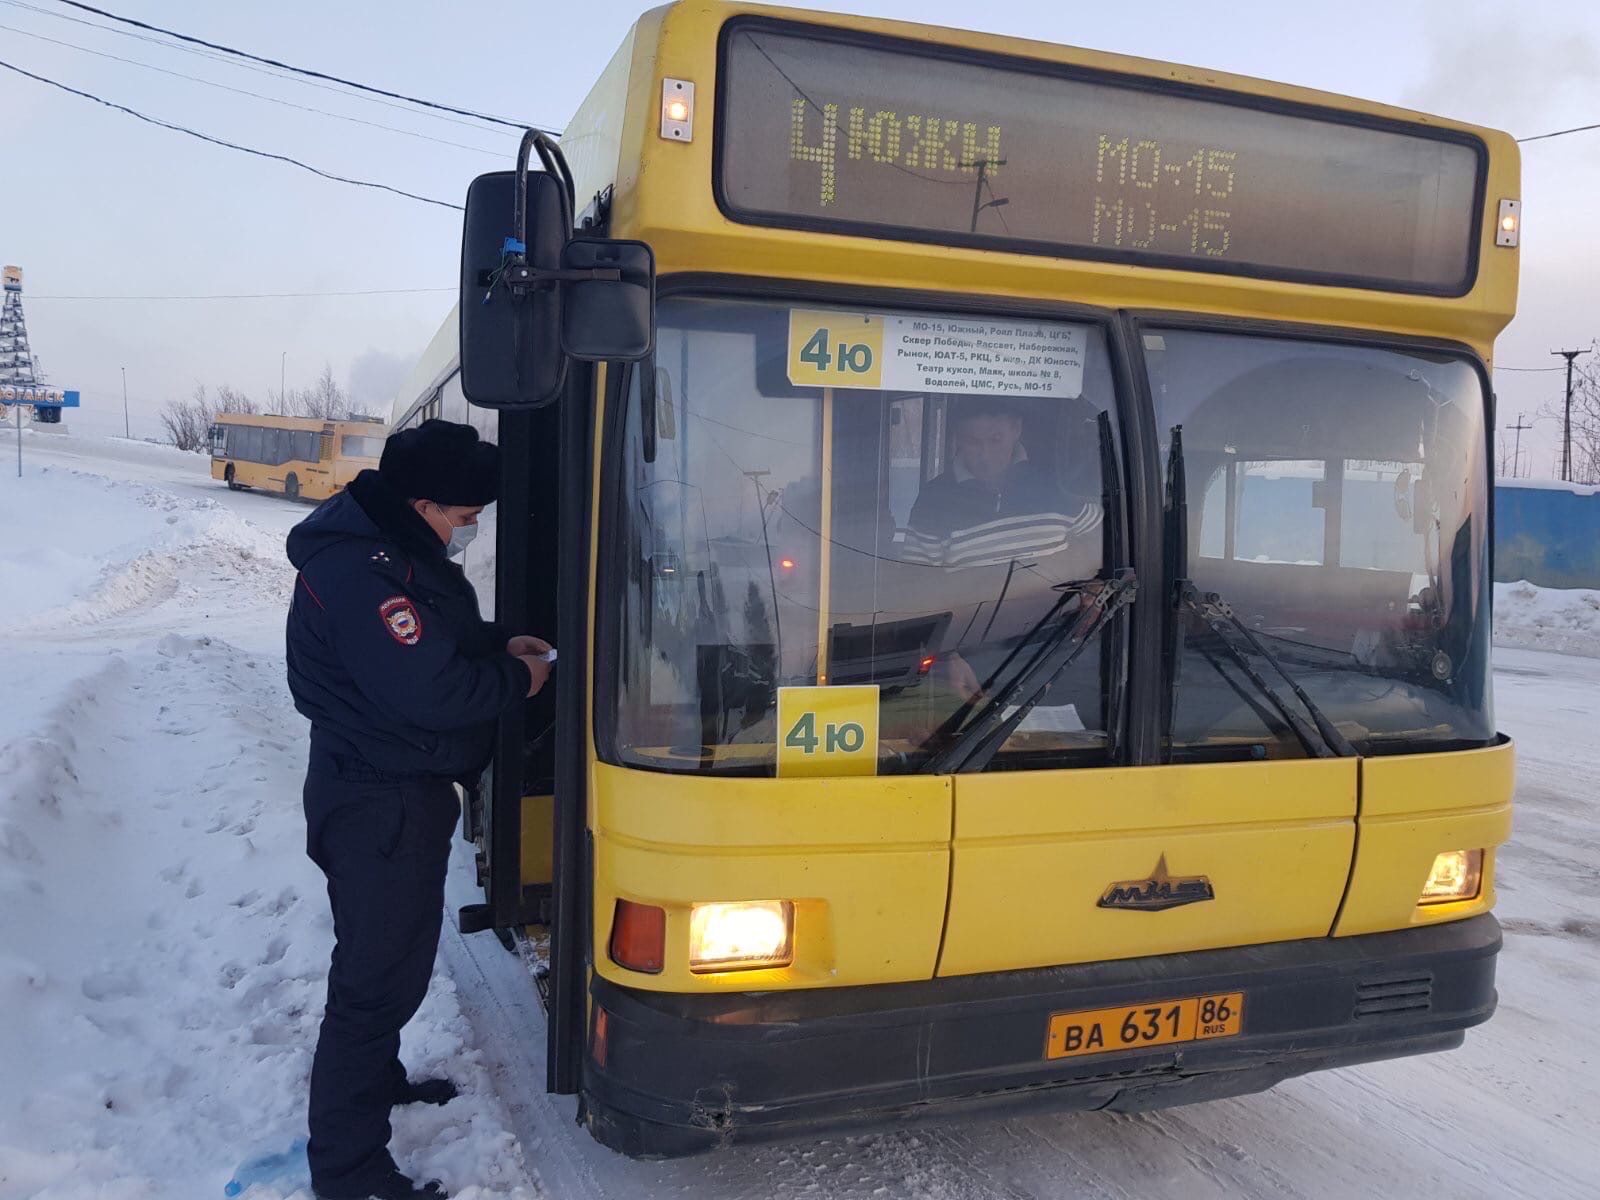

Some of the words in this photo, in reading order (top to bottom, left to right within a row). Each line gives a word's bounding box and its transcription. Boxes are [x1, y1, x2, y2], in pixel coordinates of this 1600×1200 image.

[902, 335, 931, 345] Сквер
[898, 349, 931, 359] Рынок,
[935, 351, 968, 361] ЮАТ-5,
[971, 353, 992, 363] РКЦ,
[995, 354, 1001, 362] 5
[1028, 356, 1041, 365] ДК
[1044, 356, 1081, 368] Юность,
[917, 363, 944, 373] Театр
[946, 367, 977, 376] кукол,
[979, 367, 1006, 377] Маяк,
[925, 377, 968, 388] Водолей,
[971, 380, 995, 390] ЦМС,
[998, 381, 1021, 391] Русь,
[1024, 382, 1052, 391] МО-15
[1201, 997, 1231, 1024] 86
[1120, 1006, 1181, 1043] 631
[1203, 1024, 1226, 1035] RUS
